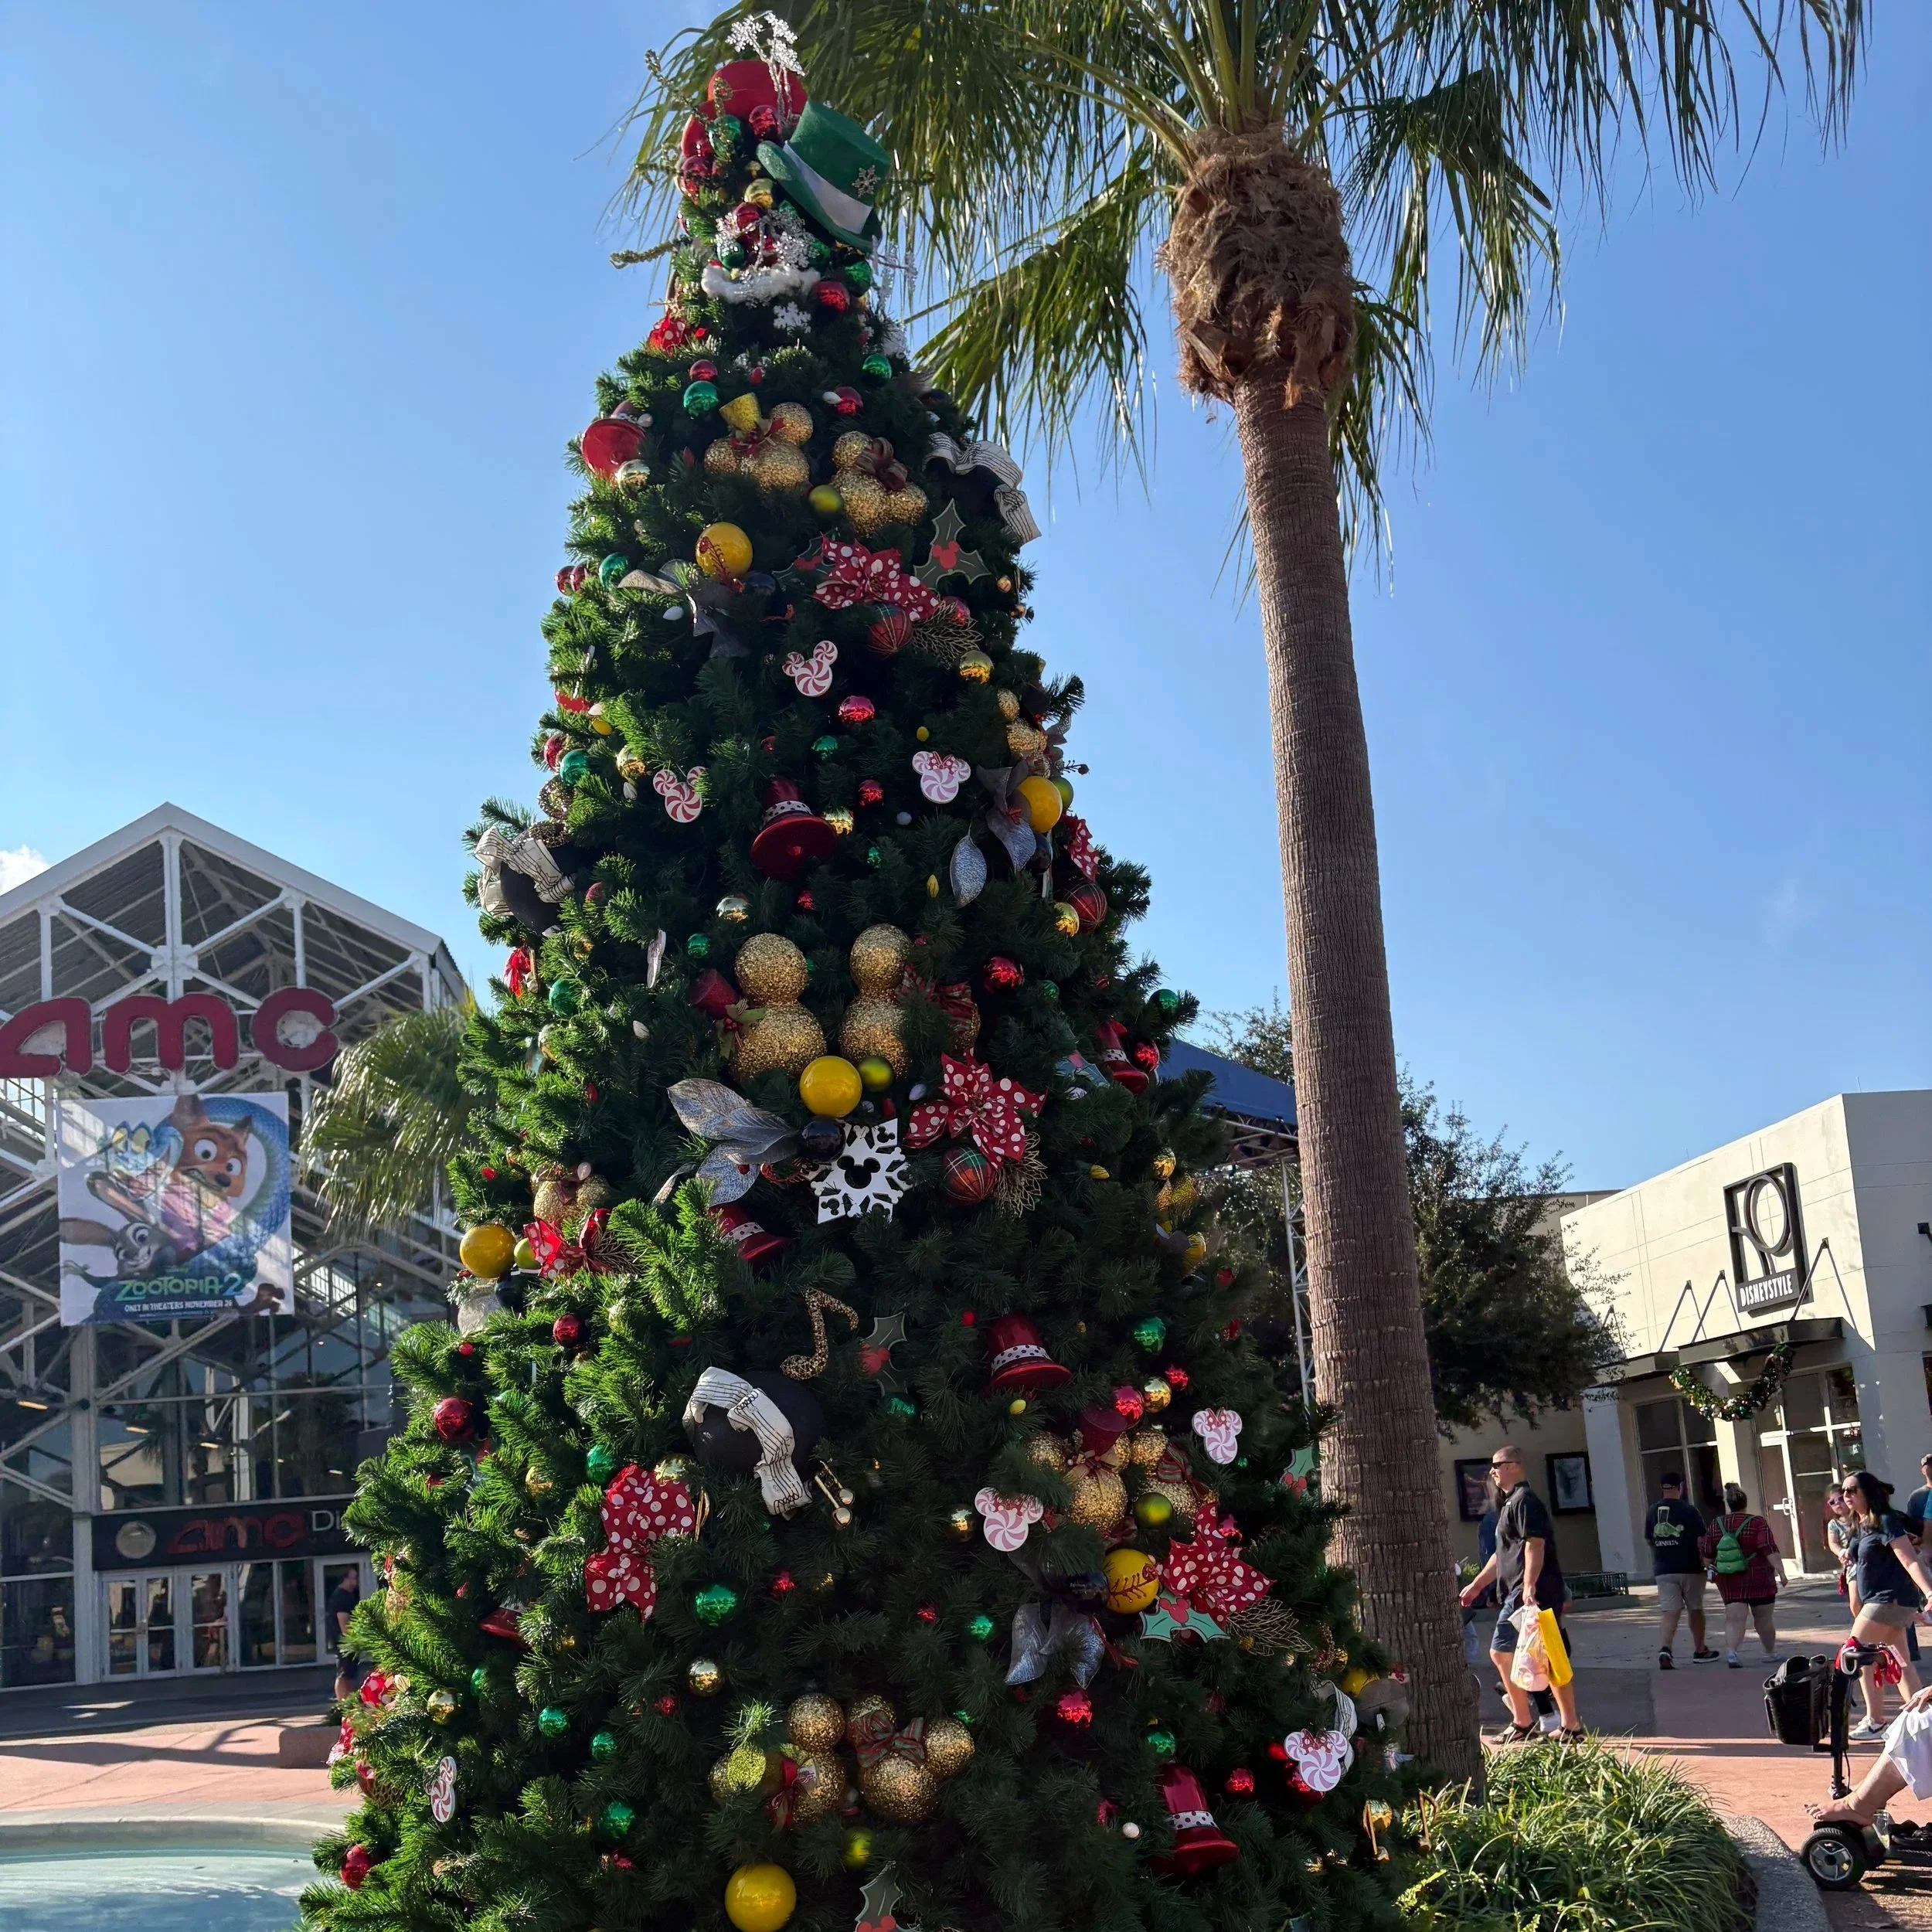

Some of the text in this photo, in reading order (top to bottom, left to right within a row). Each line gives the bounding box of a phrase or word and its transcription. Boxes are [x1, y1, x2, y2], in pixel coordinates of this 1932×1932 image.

[0, 987, 340, 1079] amc
[114, 1273, 243, 1301] ZOOTOPIA 2
[1740, 1274, 1793, 1307] DISNEYSTYLE
[124, 1303, 141, 1312] ONLY
[167, 1510, 340, 1554] amc DI
